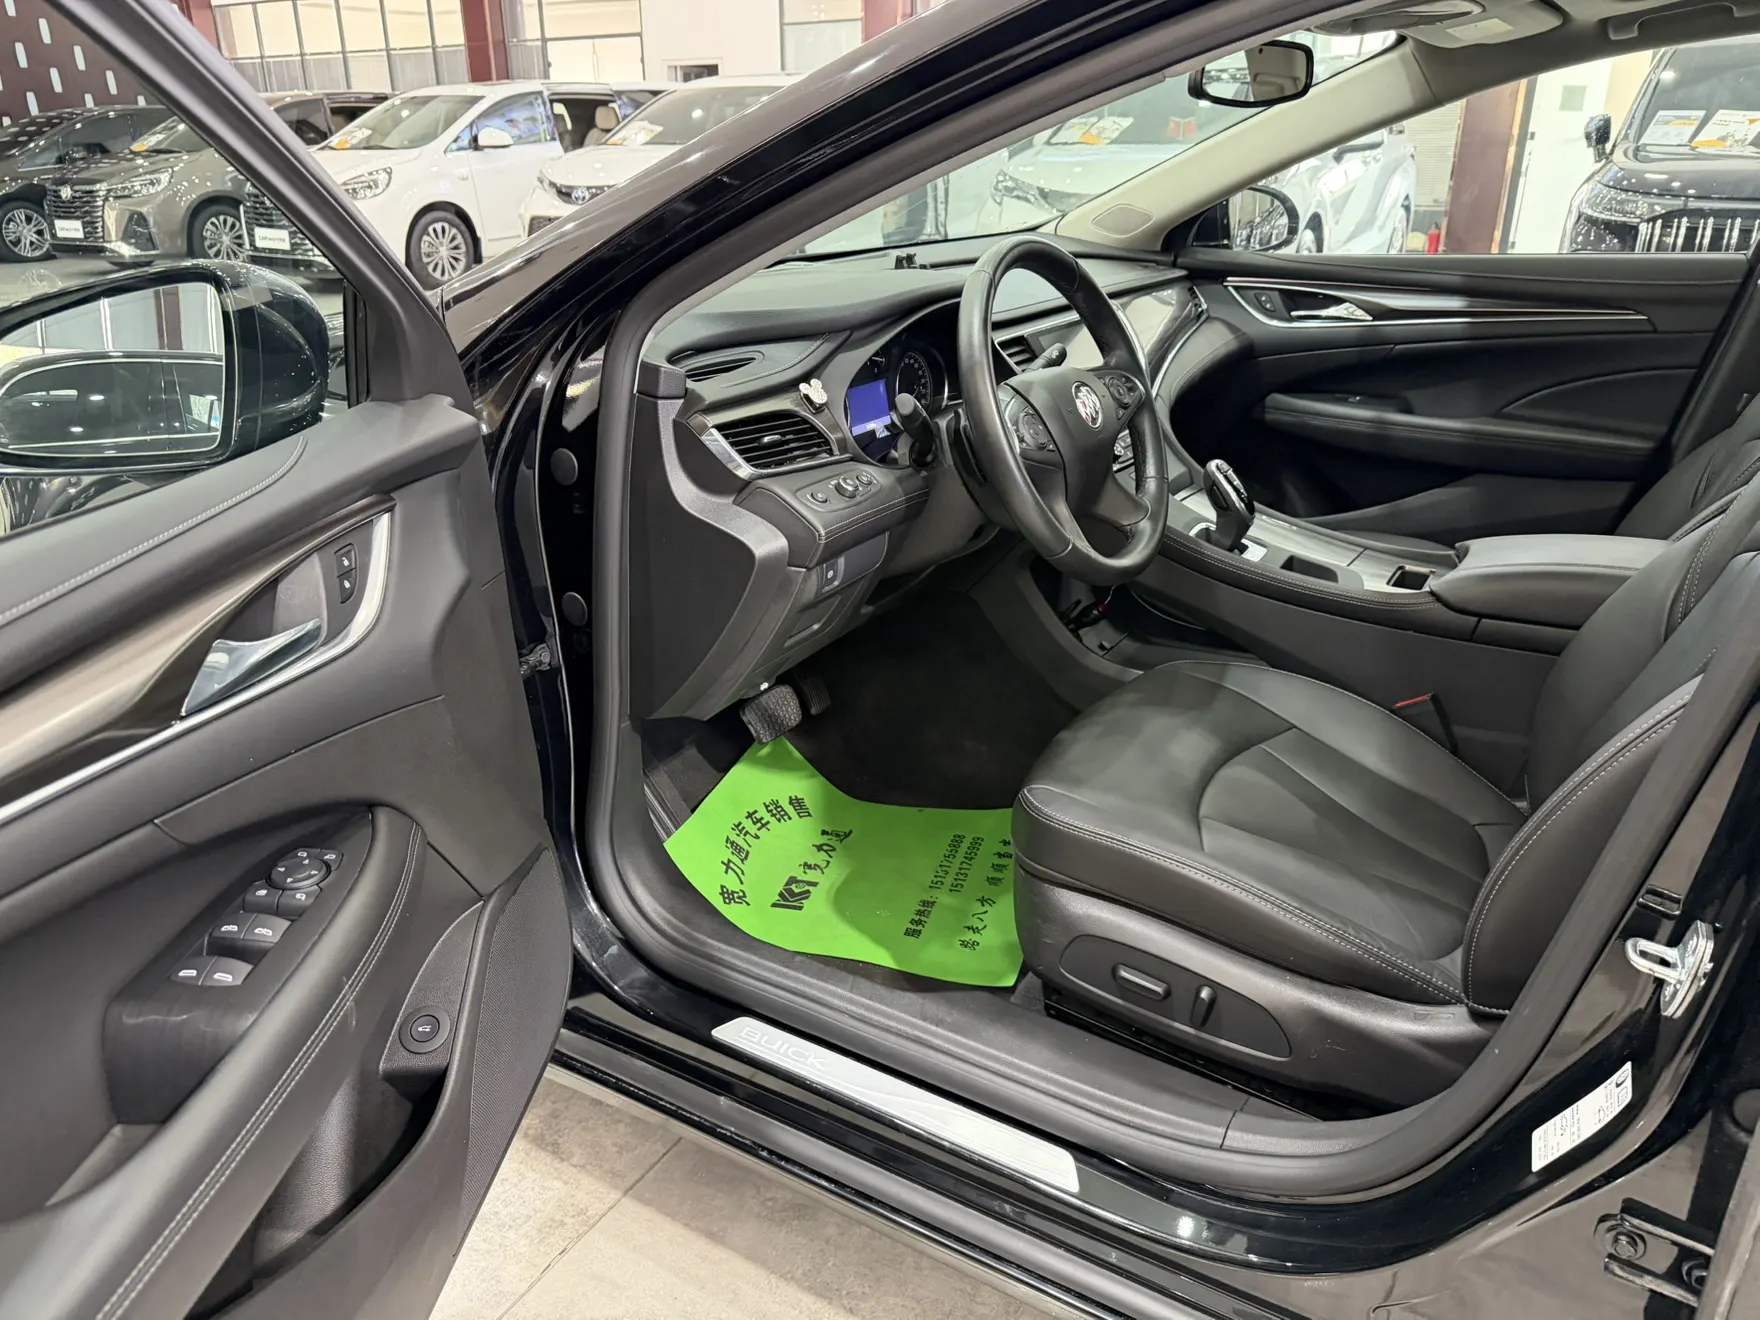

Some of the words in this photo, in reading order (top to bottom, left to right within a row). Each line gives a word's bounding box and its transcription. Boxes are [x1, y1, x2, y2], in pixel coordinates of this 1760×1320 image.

[718, 794, 813, 907] 宽力通汽车销售
[949, 836, 985, 893] 15131745999
[740, 1026, 829, 1070] BUICK
